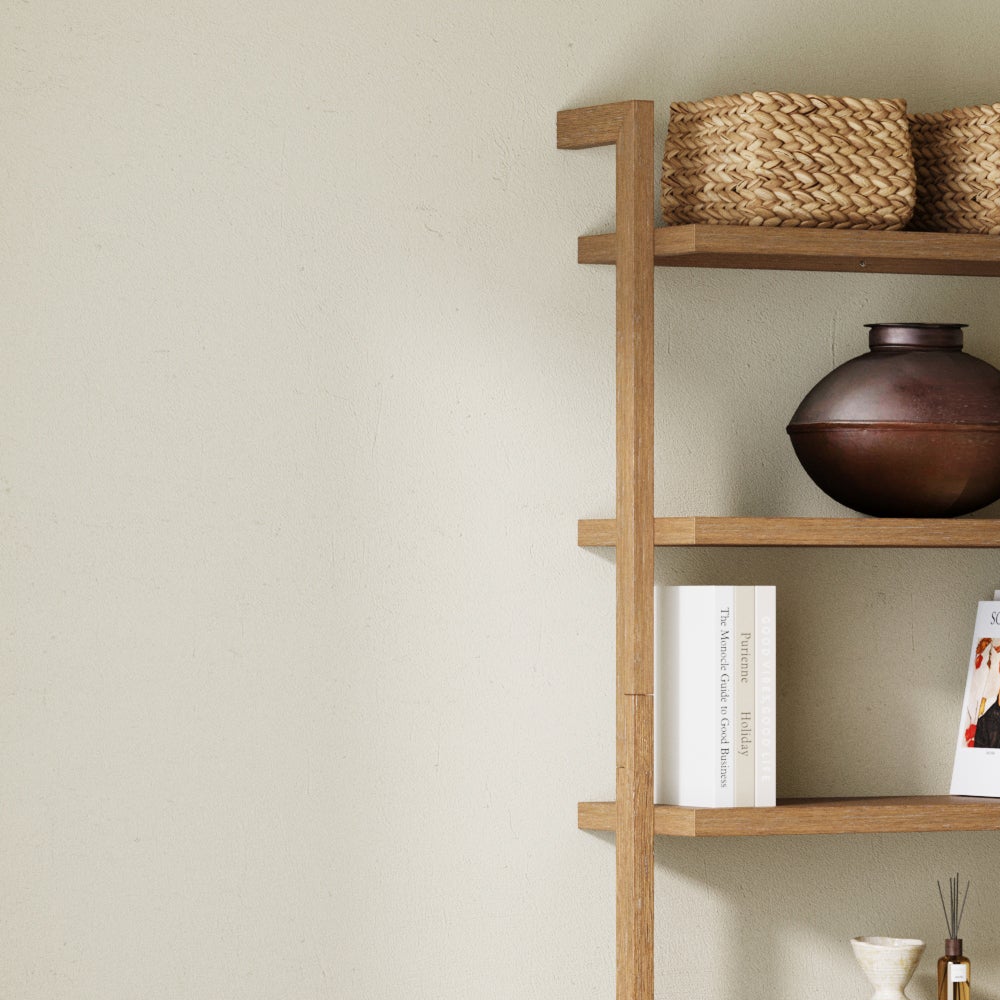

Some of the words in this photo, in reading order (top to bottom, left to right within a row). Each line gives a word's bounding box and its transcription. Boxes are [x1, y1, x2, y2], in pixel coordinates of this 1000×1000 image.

[720, 607, 730, 627] The
[720, 630, 730, 671] Monocle
[740, 632, 751, 683] Purienne
[720, 673, 730, 702] Guide
[720, 706, 729, 715] to
[720, 718, 730, 744] Good
[737, 712, 751, 757] Holiday
[720, 747, 730, 788] Business
